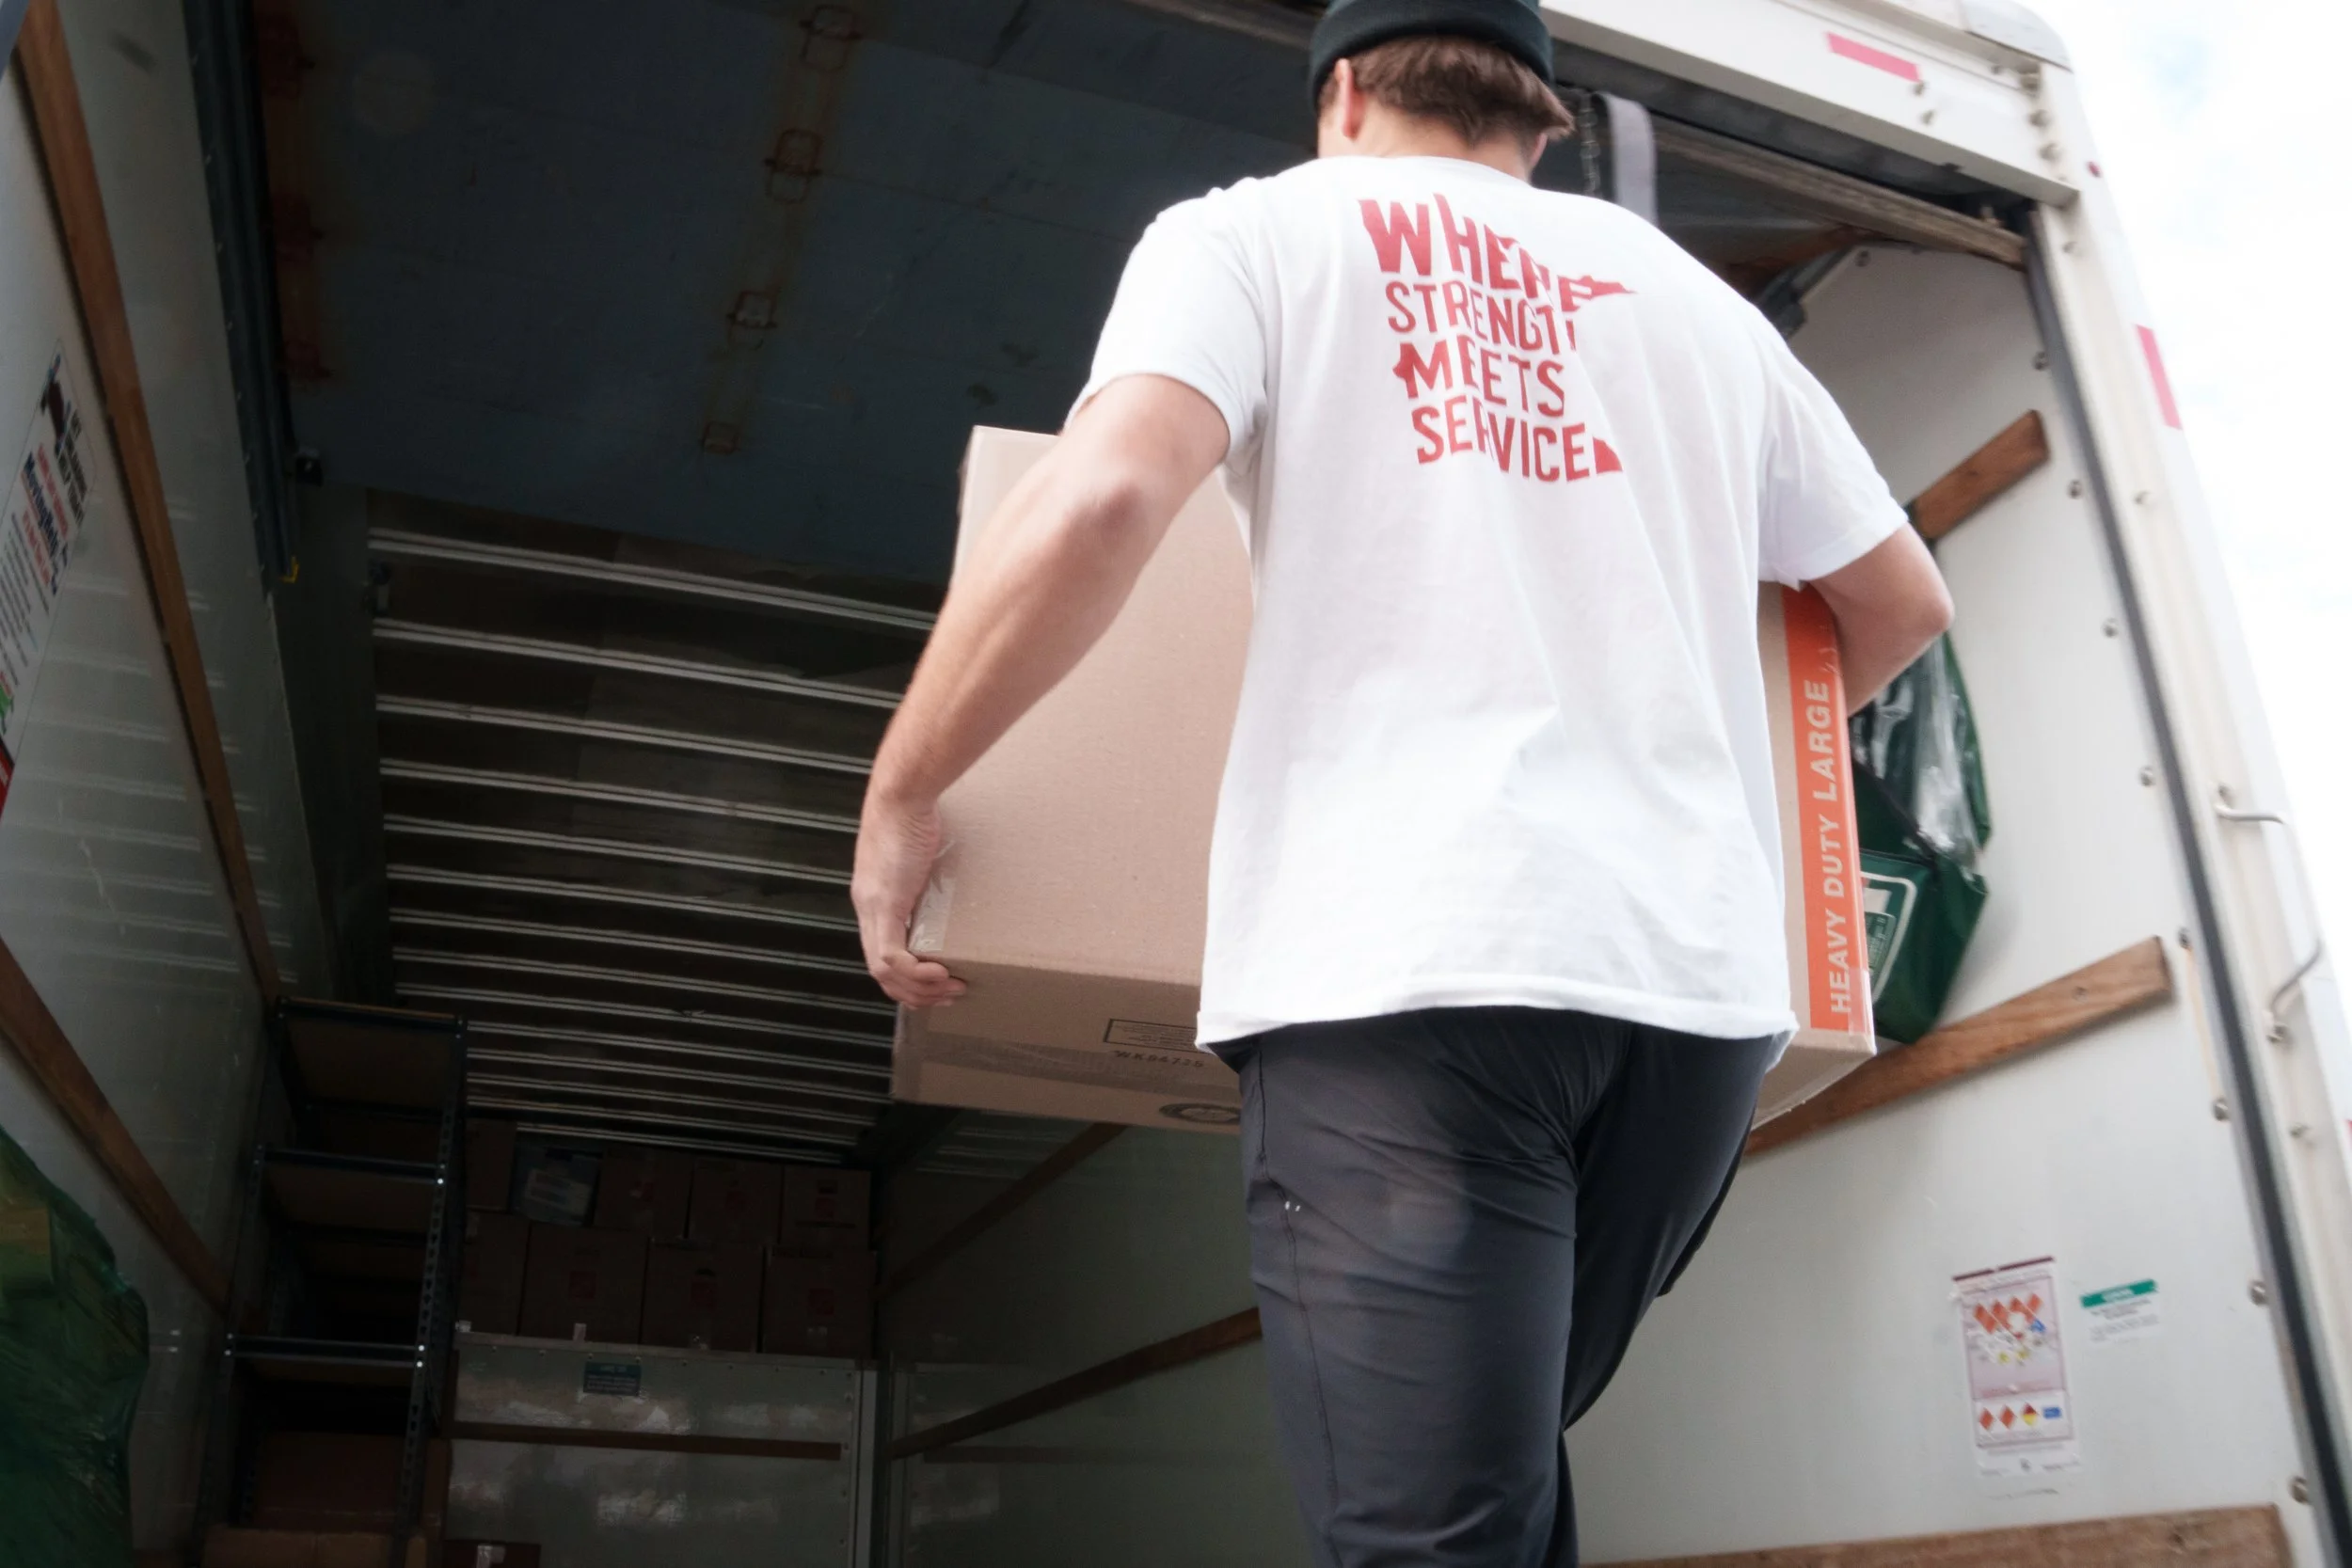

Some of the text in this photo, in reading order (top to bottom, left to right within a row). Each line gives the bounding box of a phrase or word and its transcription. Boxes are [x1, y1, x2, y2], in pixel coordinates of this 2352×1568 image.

[1358, 192, 1638, 312] WHERE
[1392, 333, 1565, 418] MEETS
[1411, 394, 1590, 483] SERVICE
[1804, 679, 1852, 1013] HEAVY DUTY LARGE
